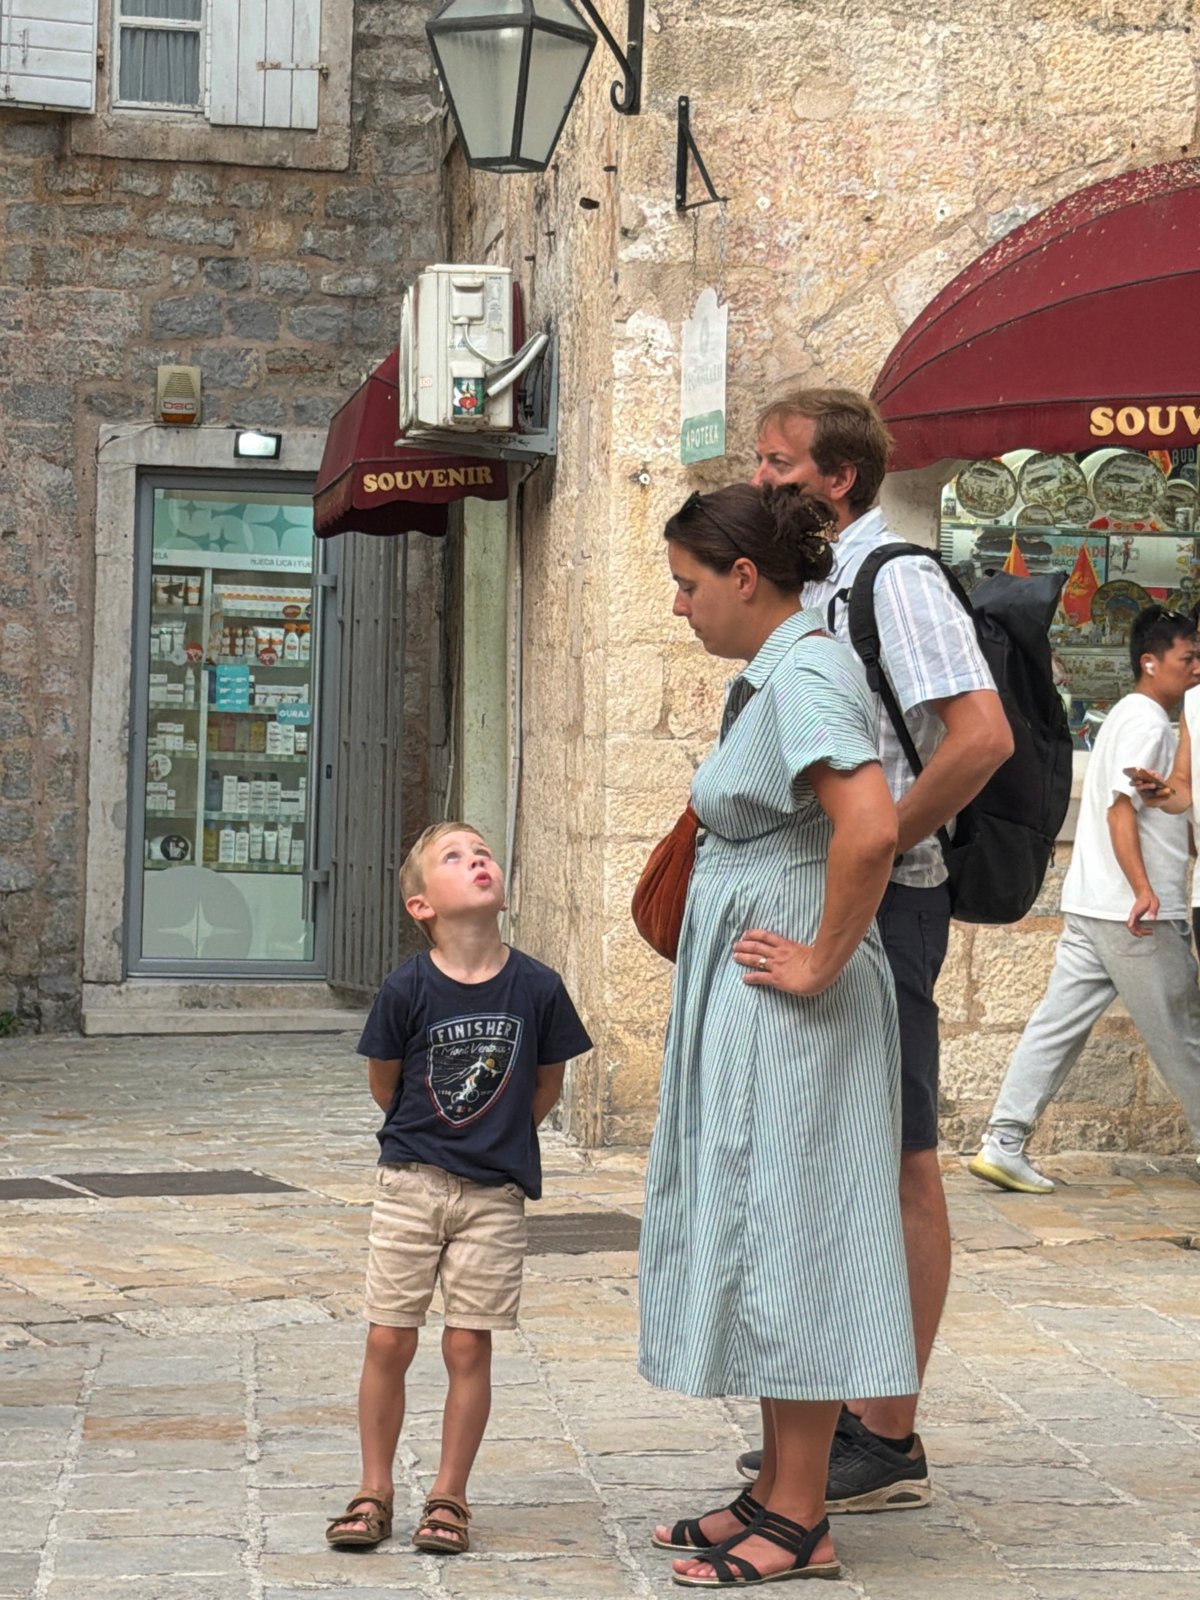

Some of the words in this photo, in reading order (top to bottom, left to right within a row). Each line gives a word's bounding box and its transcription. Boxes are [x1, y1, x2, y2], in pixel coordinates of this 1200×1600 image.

[1090, 406, 1200, 437] SOUV
[686, 423, 719, 449] APOTEKA
[363, 466, 493, 493] SOUVENIR
[437, 1021, 512, 1042] FINISHER
